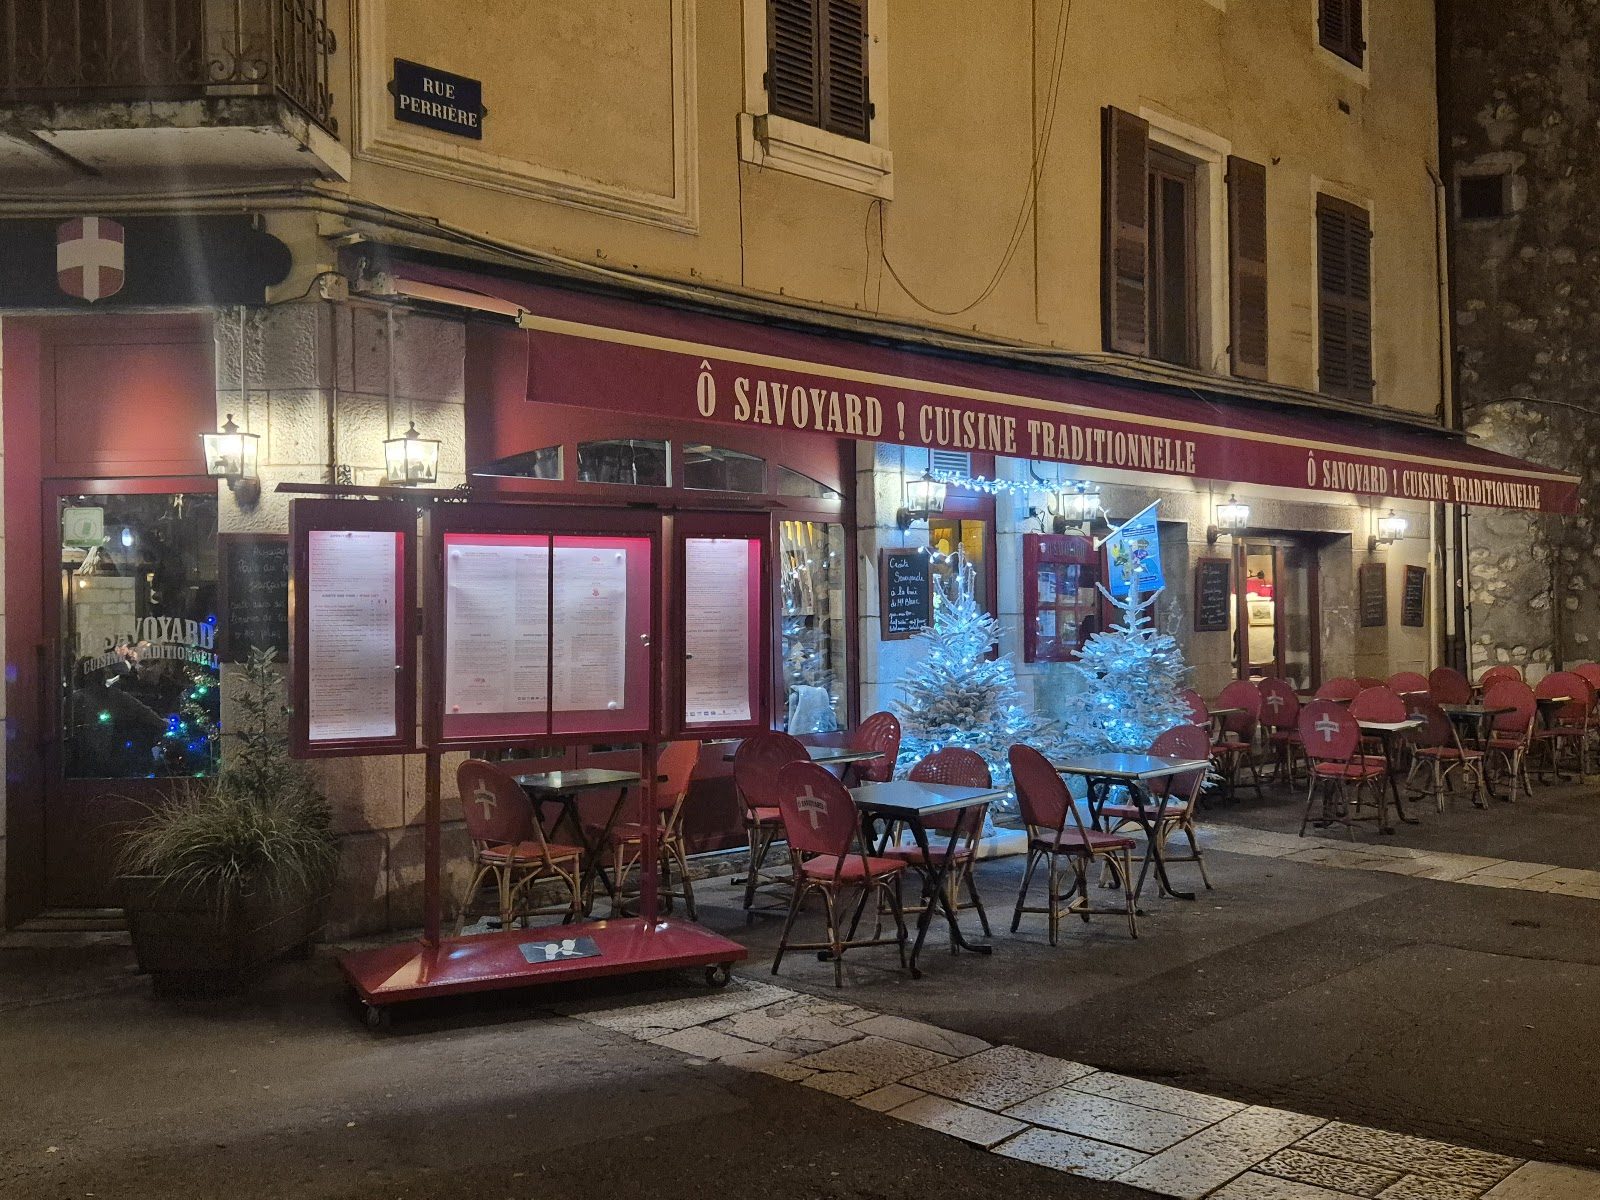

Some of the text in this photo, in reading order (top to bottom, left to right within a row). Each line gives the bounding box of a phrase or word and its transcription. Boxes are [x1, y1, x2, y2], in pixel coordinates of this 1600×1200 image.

[423, 77, 455, 100] RUE
[696, 359, 1196, 474] Ô SAVOYARD ! CUISINE TRADITIONNELLE
[1307, 450, 1541, 509] Ô SAVOYARD ! CUISINE TRADITIONNELLE
